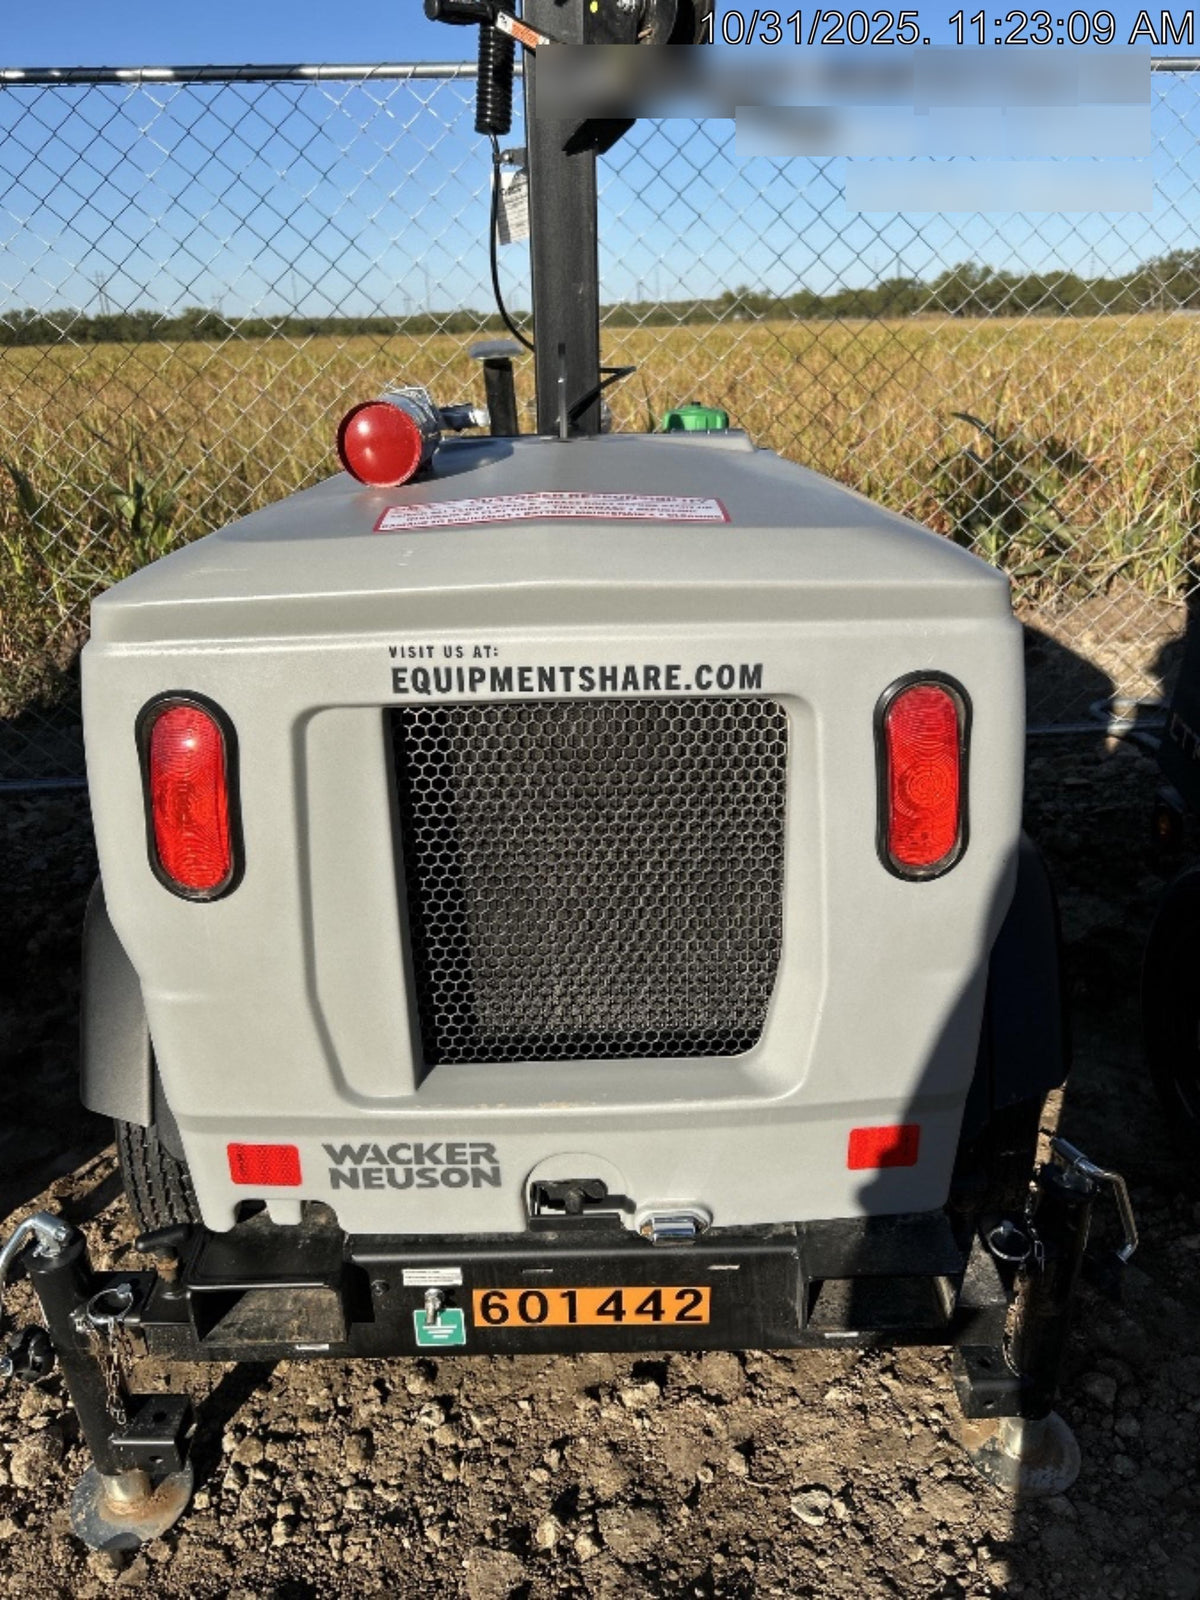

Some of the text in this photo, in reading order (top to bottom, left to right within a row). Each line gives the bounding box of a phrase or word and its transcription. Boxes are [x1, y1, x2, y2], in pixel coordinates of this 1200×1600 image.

[388, 645, 499, 659] VISIT US AT:
[390, 663, 764, 695] EQUIPMENTSHARE.COM
[321, 1142, 500, 1166] WACKER
[328, 1166, 502, 1190] NEUSON
[480, 1287, 704, 1326] 601442
